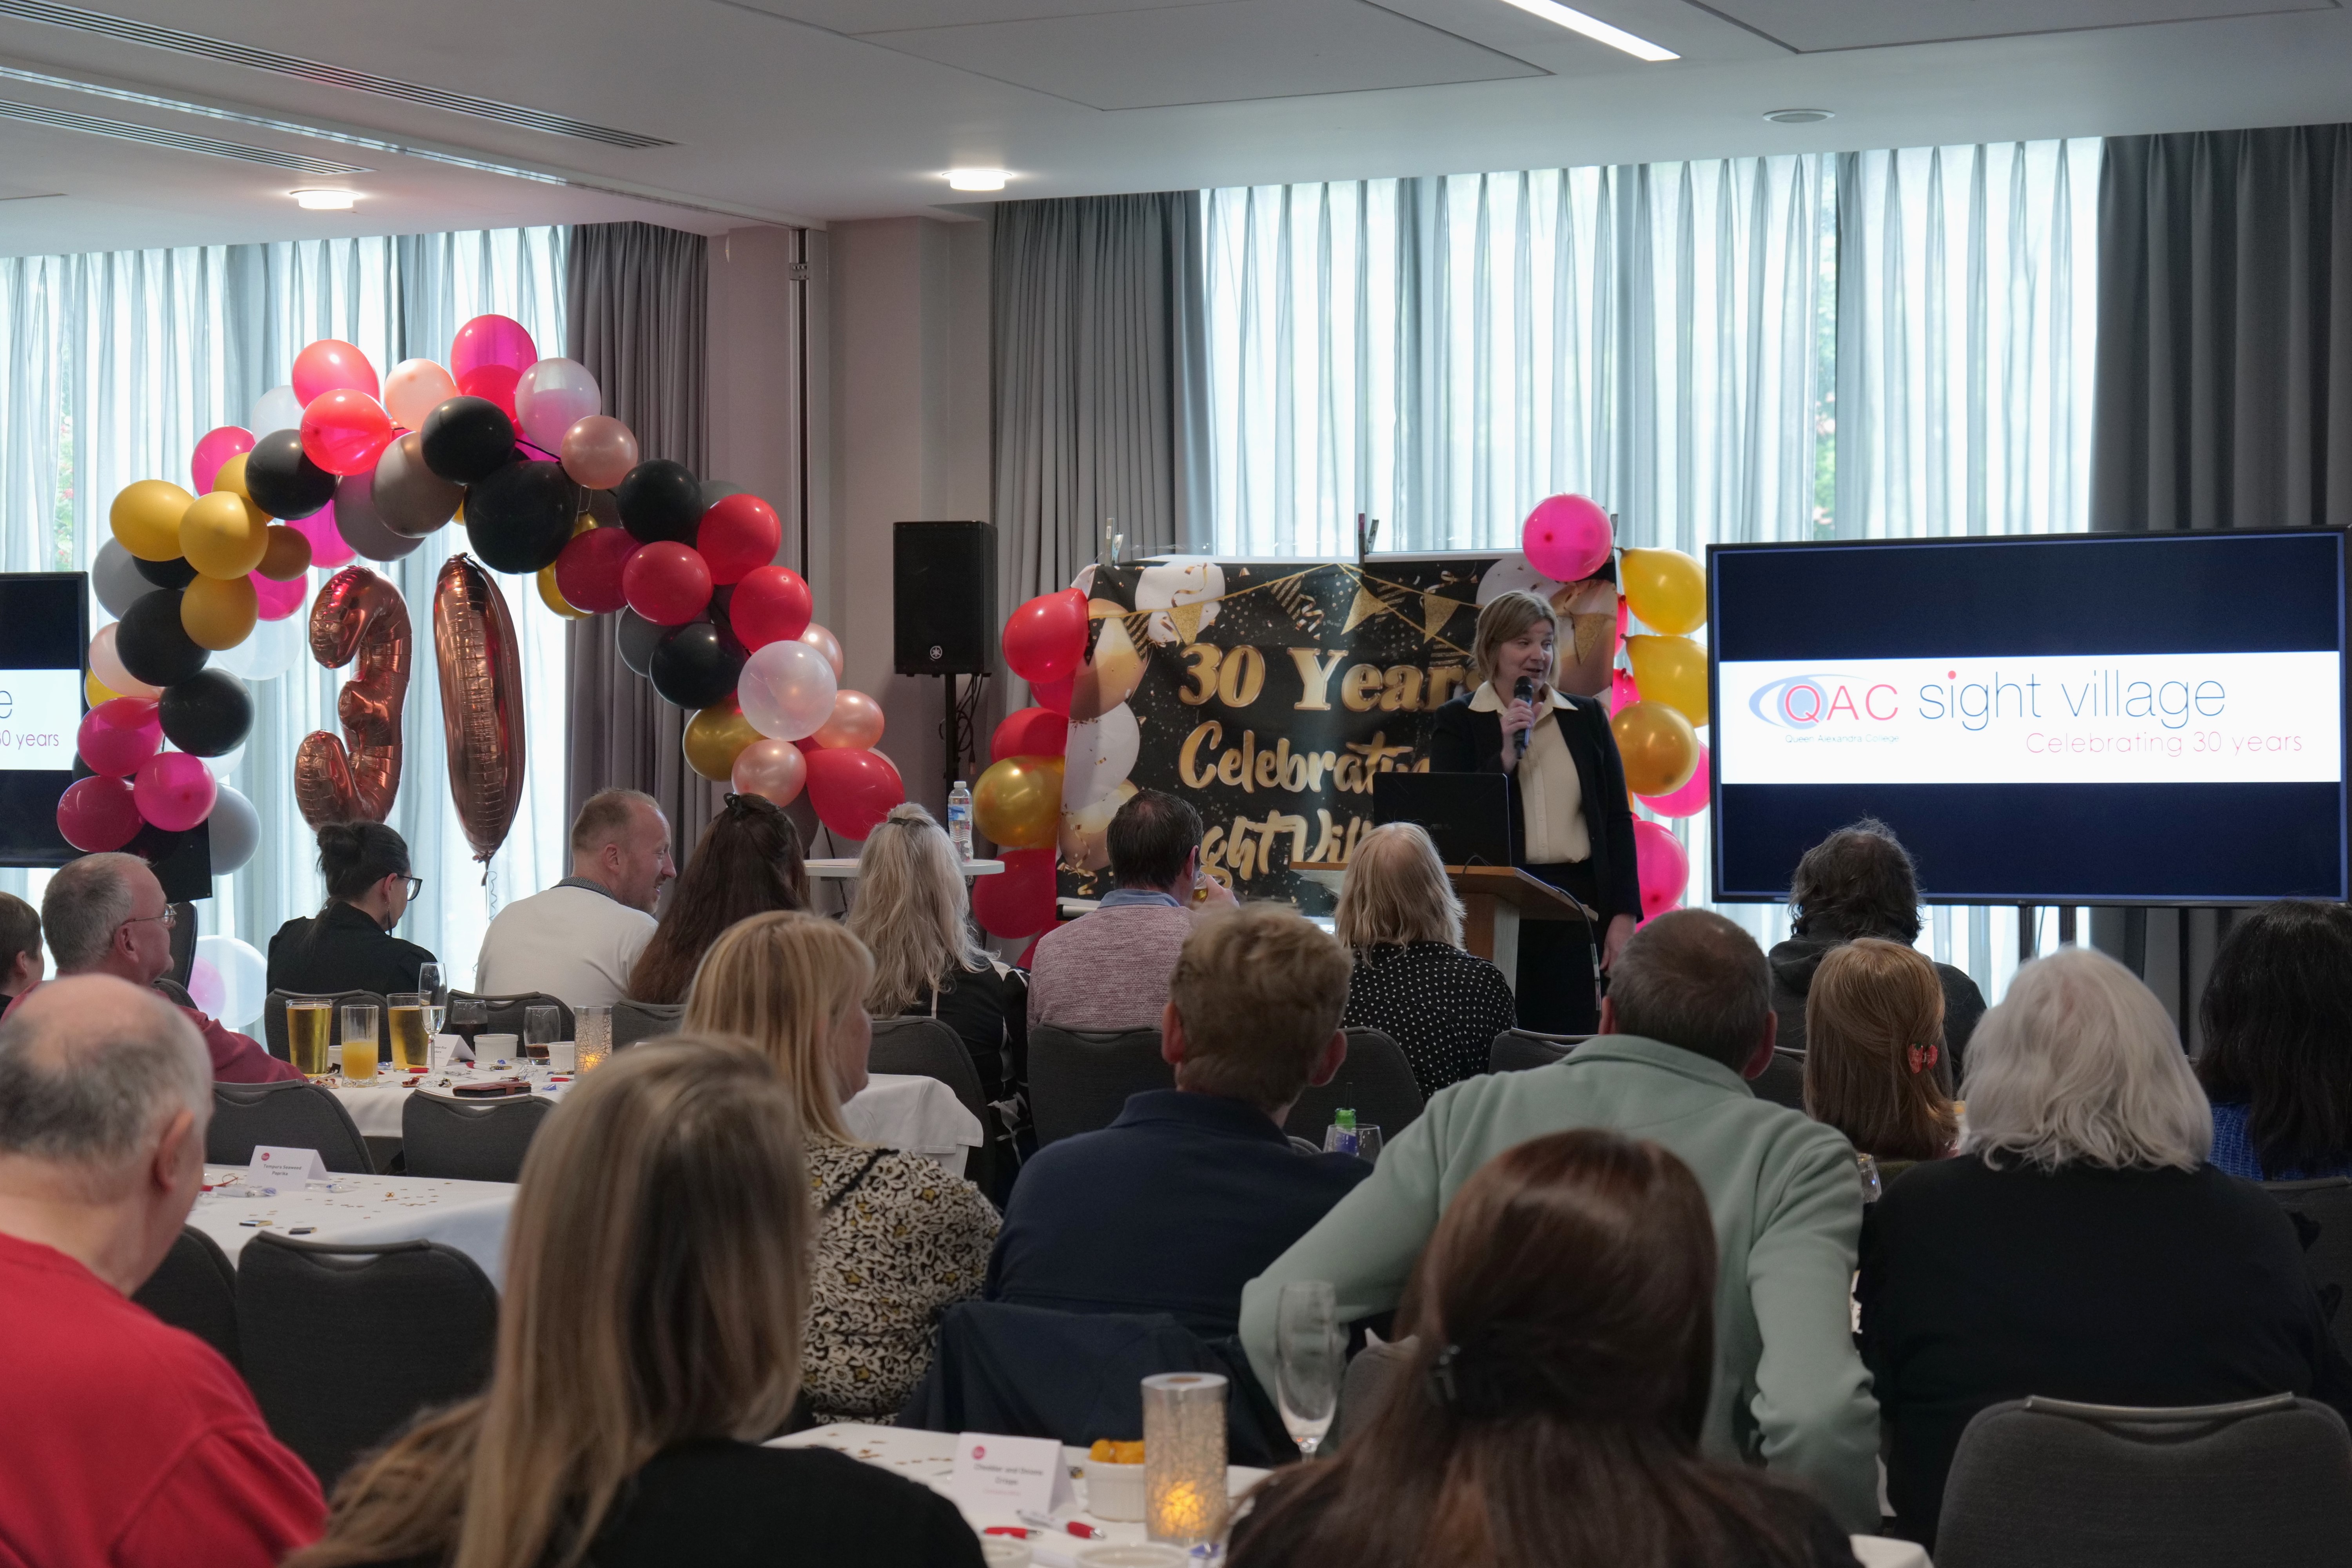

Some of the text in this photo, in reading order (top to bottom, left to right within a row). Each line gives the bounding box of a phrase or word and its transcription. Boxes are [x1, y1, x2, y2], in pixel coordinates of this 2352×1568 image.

[1178, 643, 1266, 708] 30
[1785, 684, 1898, 723] QAC
[1919, 669, 2226, 731] sight village
[16, 734, 59, 750] years
[1179, 720, 1430, 795] Celebrat
[1785, 734, 1899, 744] Queen Alexandra College
[2027, 731, 2302, 757] Celebrating 30 years
